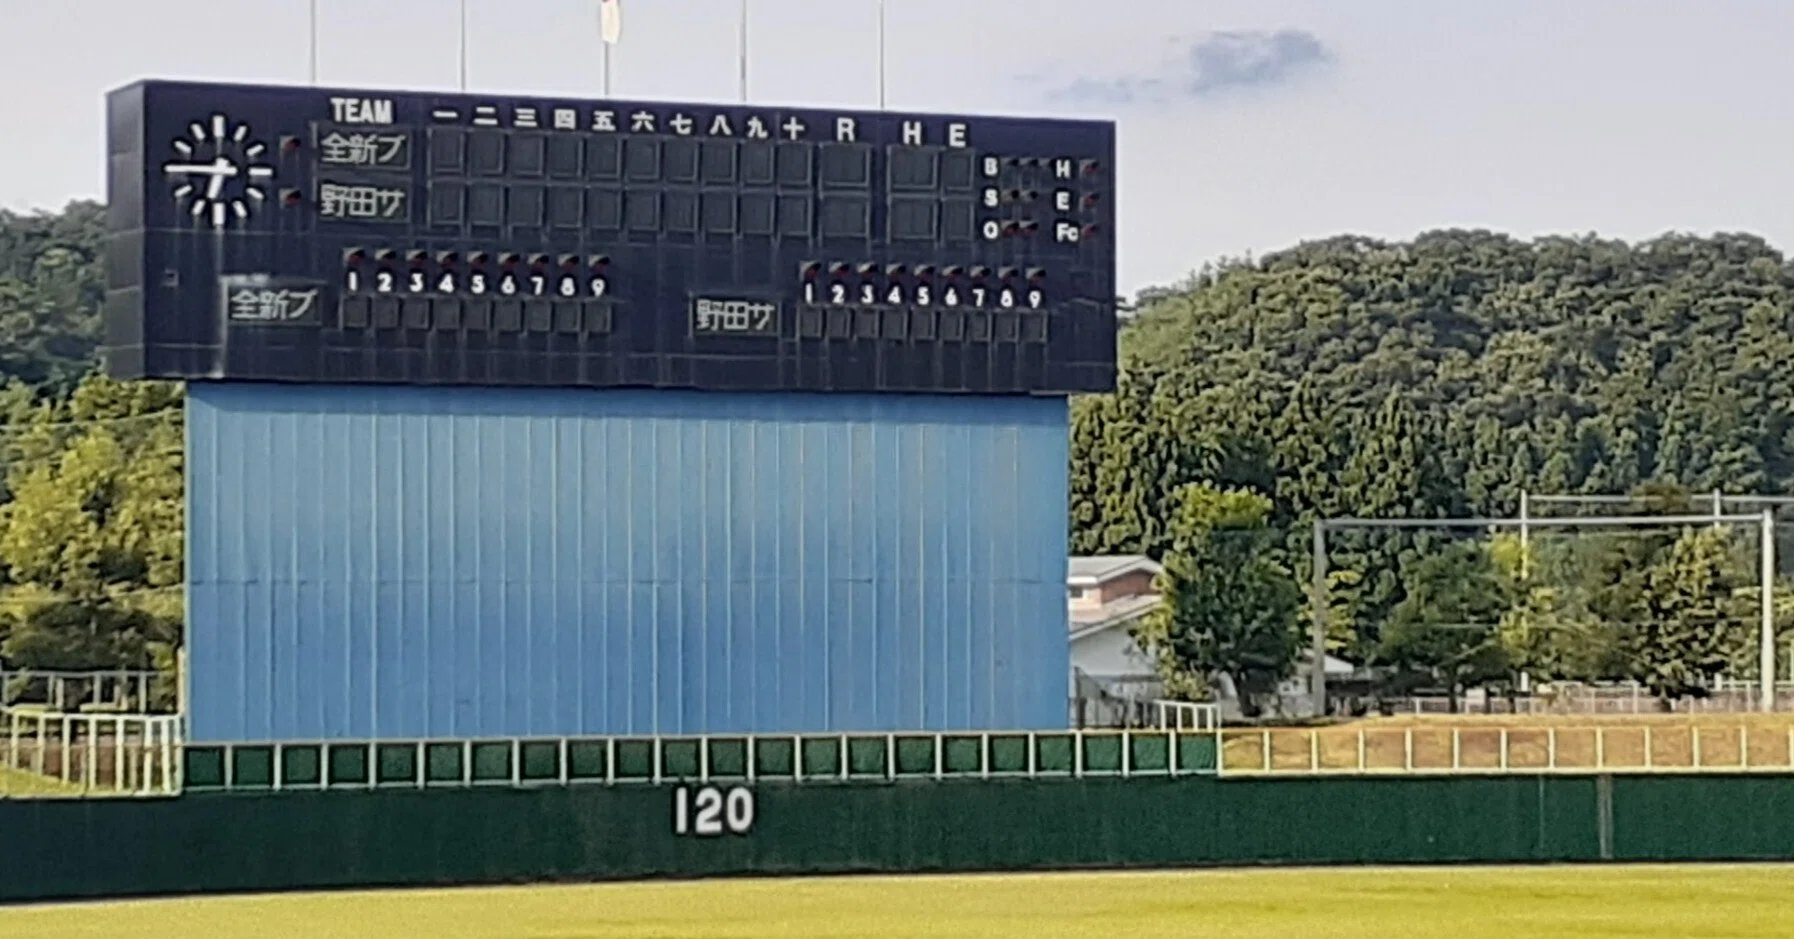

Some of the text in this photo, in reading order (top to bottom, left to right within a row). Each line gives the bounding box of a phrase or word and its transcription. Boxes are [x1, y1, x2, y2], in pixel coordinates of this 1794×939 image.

[330, 97, 393, 125] TEAM
[473, 106, 498, 126] 二
[514, 108, 538, 128] 三
[554, 108, 576, 130] 四
[592, 110, 616, 132] 五
[631, 111, 655, 132] 六
[669, 113, 692, 135] 七
[709, 114, 732, 136] 八
[747, 116, 768, 139] 九
[782, 116, 805, 141] 十
[837, 117, 966, 148] R H E
[984, 157, 1071, 178] B H
[320, 184, 405, 218] 野田サ
[984, 188, 1070, 211] S E
[349, 272, 605, 298] 1 2 3 4 5 6 7 8 9
[805, 283, 1041, 309] 1 2 3 4 5 6 7 8 9
[696, 298, 776, 331] 野田サ
[676, 786, 754, 834] 120
